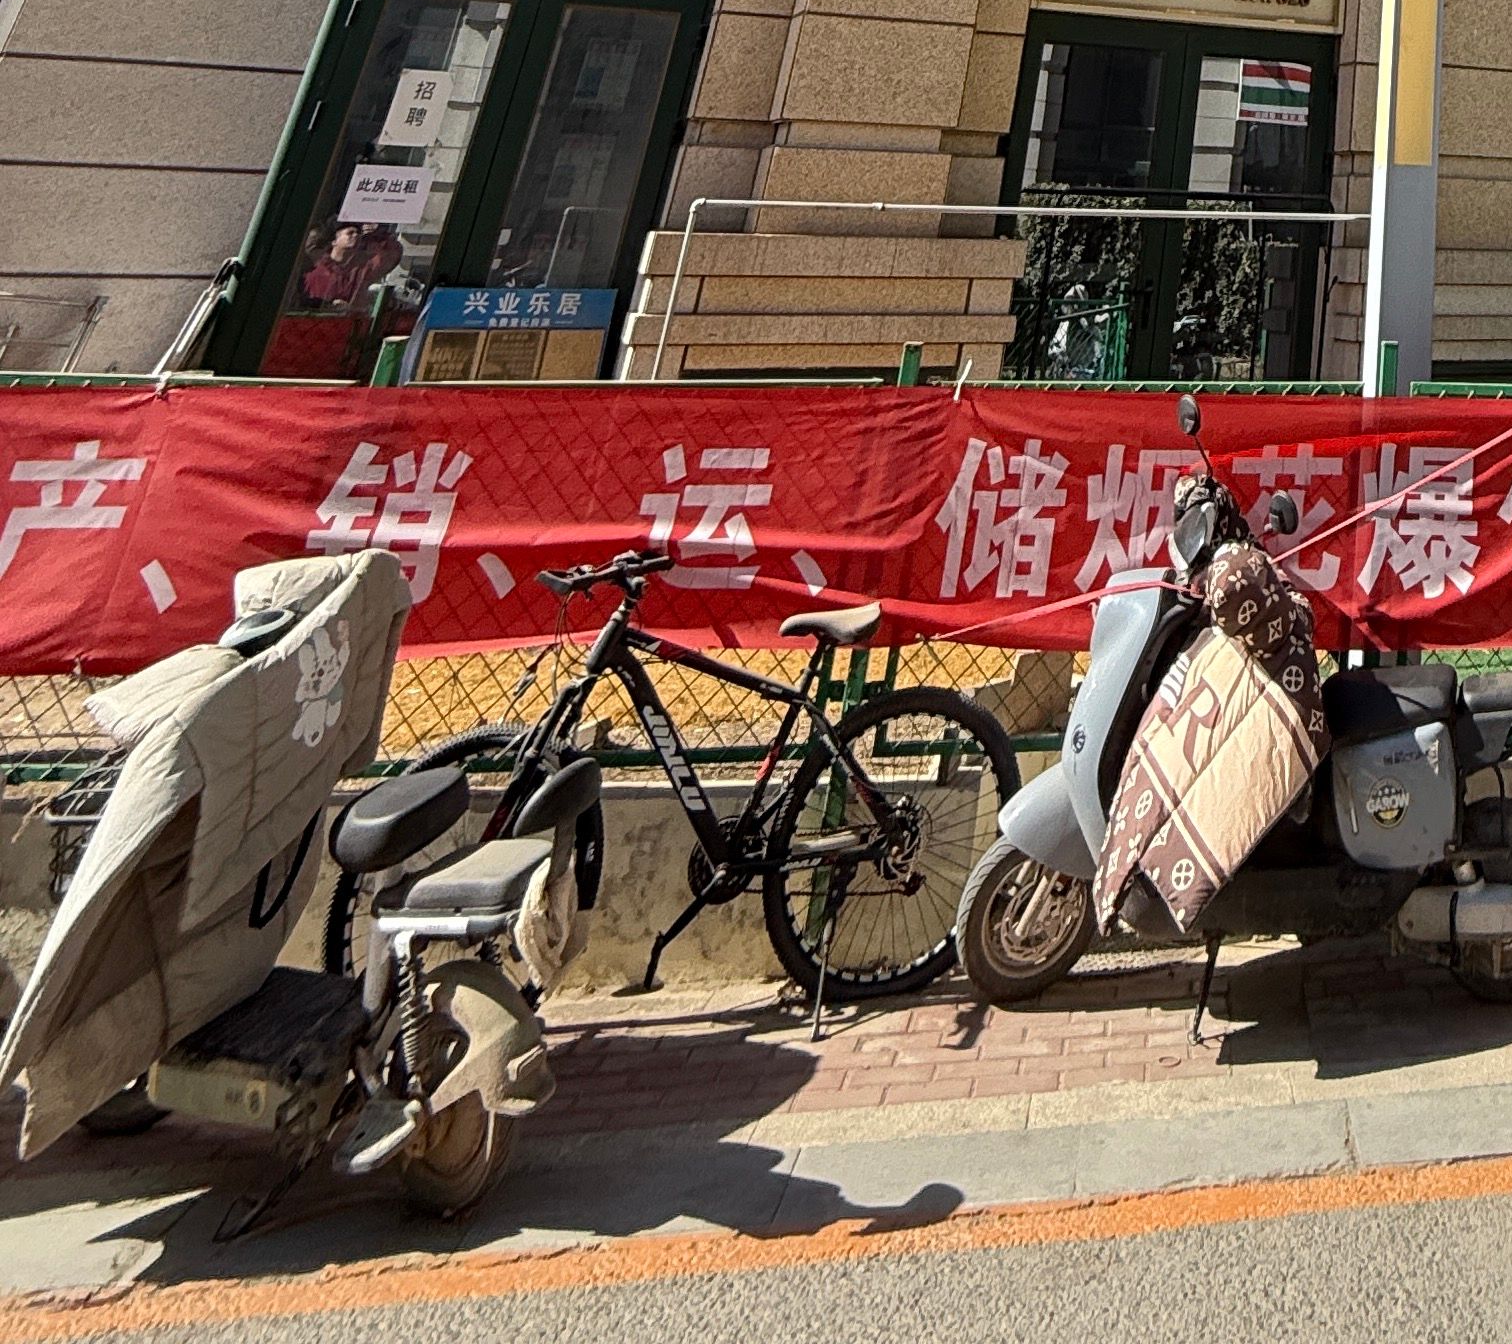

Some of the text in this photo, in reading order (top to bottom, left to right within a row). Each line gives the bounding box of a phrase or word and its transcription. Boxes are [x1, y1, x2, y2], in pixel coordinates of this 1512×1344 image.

[404, 80, 437, 127] 招聘
[356, 177, 419, 194] 此房出租
[463, 290, 582, 316] 兴业乐居
[643, 705, 706, 810] JINLU
